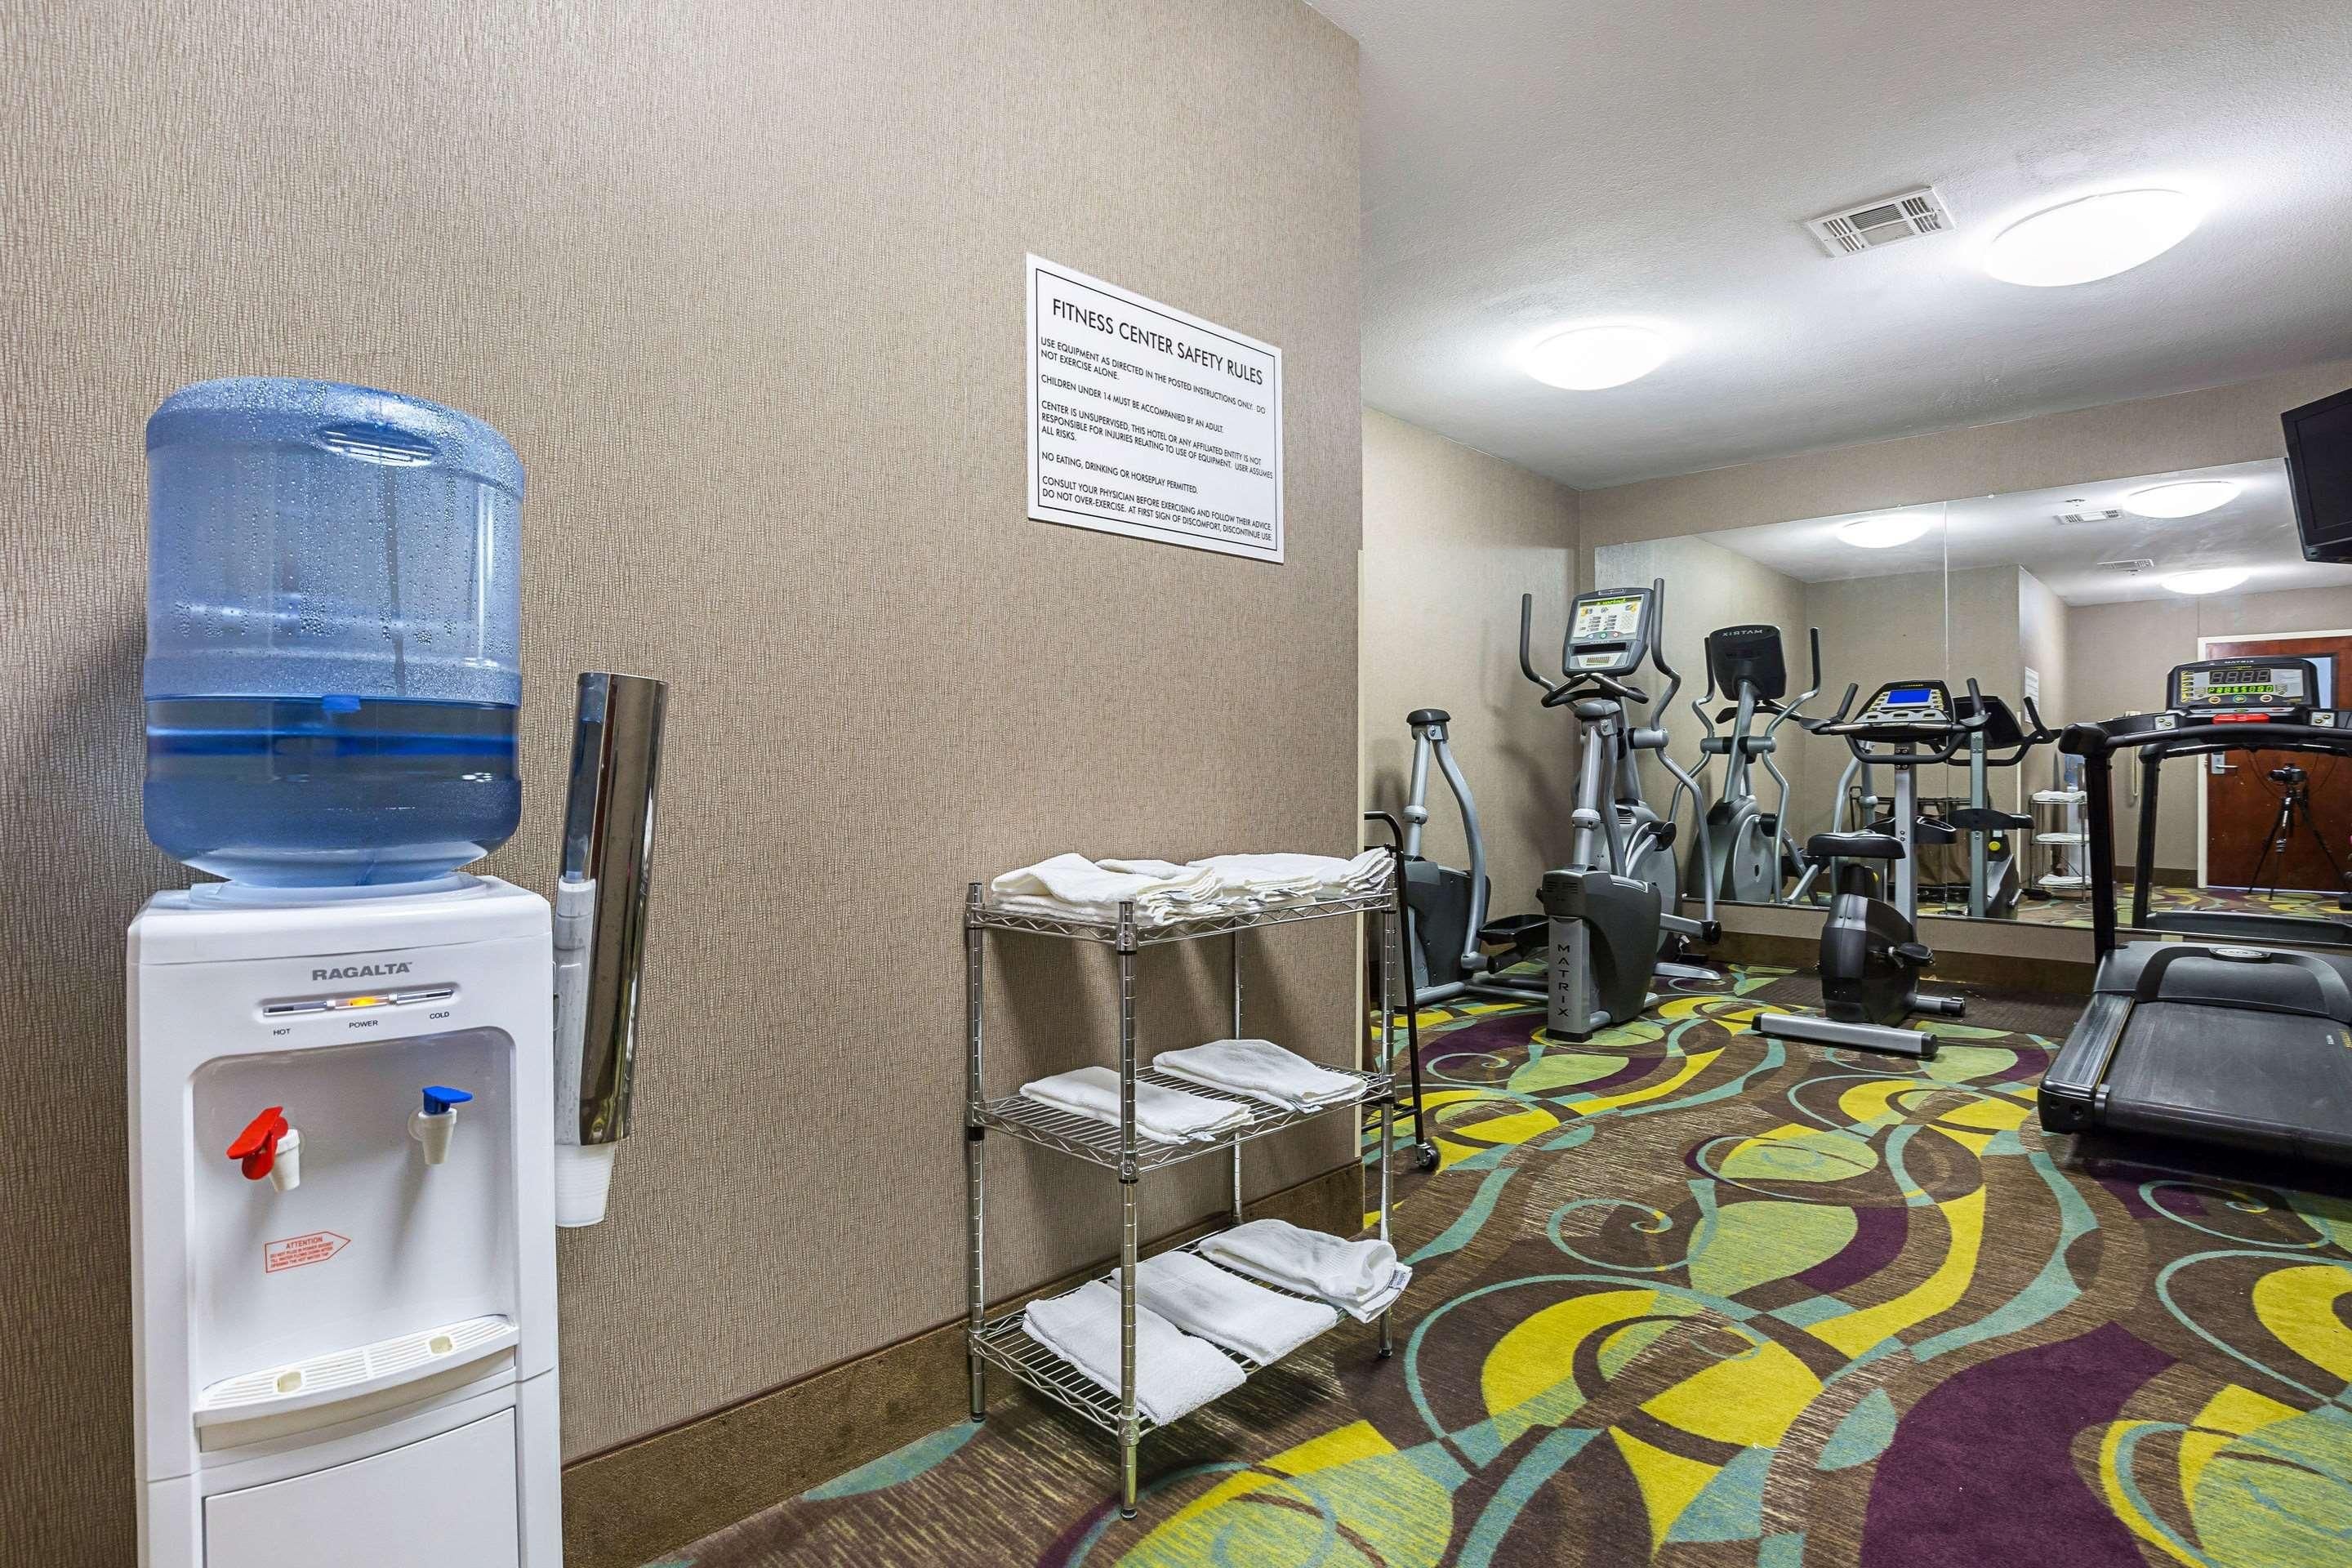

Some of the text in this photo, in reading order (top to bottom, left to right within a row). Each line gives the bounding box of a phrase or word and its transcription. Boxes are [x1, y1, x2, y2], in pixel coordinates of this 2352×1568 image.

[1041, 349, 1058, 362] NOT
[1059, 354, 1092, 372] EXERCISE
[1053, 299, 1263, 386] FITNESS CENTER SAFETY RULES
[1041, 336, 1055, 349] USE
[1058, 342, 1099, 363] EQUIPMENT
[1101, 356, 1110, 366] AS
[1112, 359, 1144, 376] DIRECTED
[1145, 370, 1152, 379] IN
[1155, 373, 1166, 384] THE
[1168, 377, 1192, 391] POSTED
[1193, 385, 1236, 405] INSTRUCTIONS
[1256, 405, 1266, 414] DO
[1041, 374, 1076, 392] CHILDREN
[1078, 385, 1102, 399] UNDER
[1103, 392, 1111, 402] 14
[1113, 395, 1131, 407] MUST
[1132, 401, 1139, 410] BE
[1141, 403, 1186, 423] ACCOMPANIED
[1187, 416, 1194, 425] BY
[1195, 419, 1204, 428] AN
[1042, 425, 1054, 436] ALL
[1042, 400, 1069, 416] CENTER
[1071, 408, 1077, 418] IS
[1132, 425, 1145, 435] THIS
[1147, 429, 1167, 441] HOTEL
[1169, 434, 1178, 444] OR
[1179, 438, 1191, 448] ANY
[1192, 441, 1223, 456] AFFILIATED
[1224, 449, 1242, 461] ENTITY
[1250, 457, 1261, 466] NOT
[1042, 412, 1088, 432] RESPONSIBLE
[1089, 425, 1103, 436] FOR
[1105, 429, 1133, 443] INJURIES
[1134, 437, 1165, 452] RELATING
[1165, 445, 1174, 454] TO
[1176, 448, 1187, 457] USE
[1189, 451, 1197, 460] OF
[1235, 463, 1249, 473] USER
[1250, 466, 1272, 479] ASSUMES
[1042, 452, 1054, 463] NO
[1056, 455, 1083, 469] EATING,
[1085, 461, 1119, 477] DRINKING
[1120, 470, 1129, 479] OR
[1131, 472, 1165, 488] HORSEPLAY
[1042, 476, 1076, 491] CONSULT
[1079, 483, 1098, 495] YOUR
[1099, 488, 1134, 502] PHYSICIAN
[1137, 496, 1160, 508] BEFORE
[1161, 501, 1196, 514] EXERCISING
[1197, 509, 1209, 518] AND
[1212, 511, 1235, 523] FOLLOW
[1236, 517, 1250, 526] THEIR
[1043, 488, 1054, 499] DO
[1057, 492, 1072, 503] NOT
[1129, 506, 1137, 515] AT
[1138, 508, 1154, 519] FIRST
[1155, 511, 1170, 522] SIGN
[1172, 514, 1180, 523] OF
[1223, 525, 1260, 539] DISCONTINUE
[312, 963, 410, 981] RAGALTA
[1557, 944, 1570, 1017] MATRIX
[349, 1020, 378, 1029] POWER
[430, 1011, 449, 1020] COLD
[286, 1236, 323, 1250] ATTENTION
